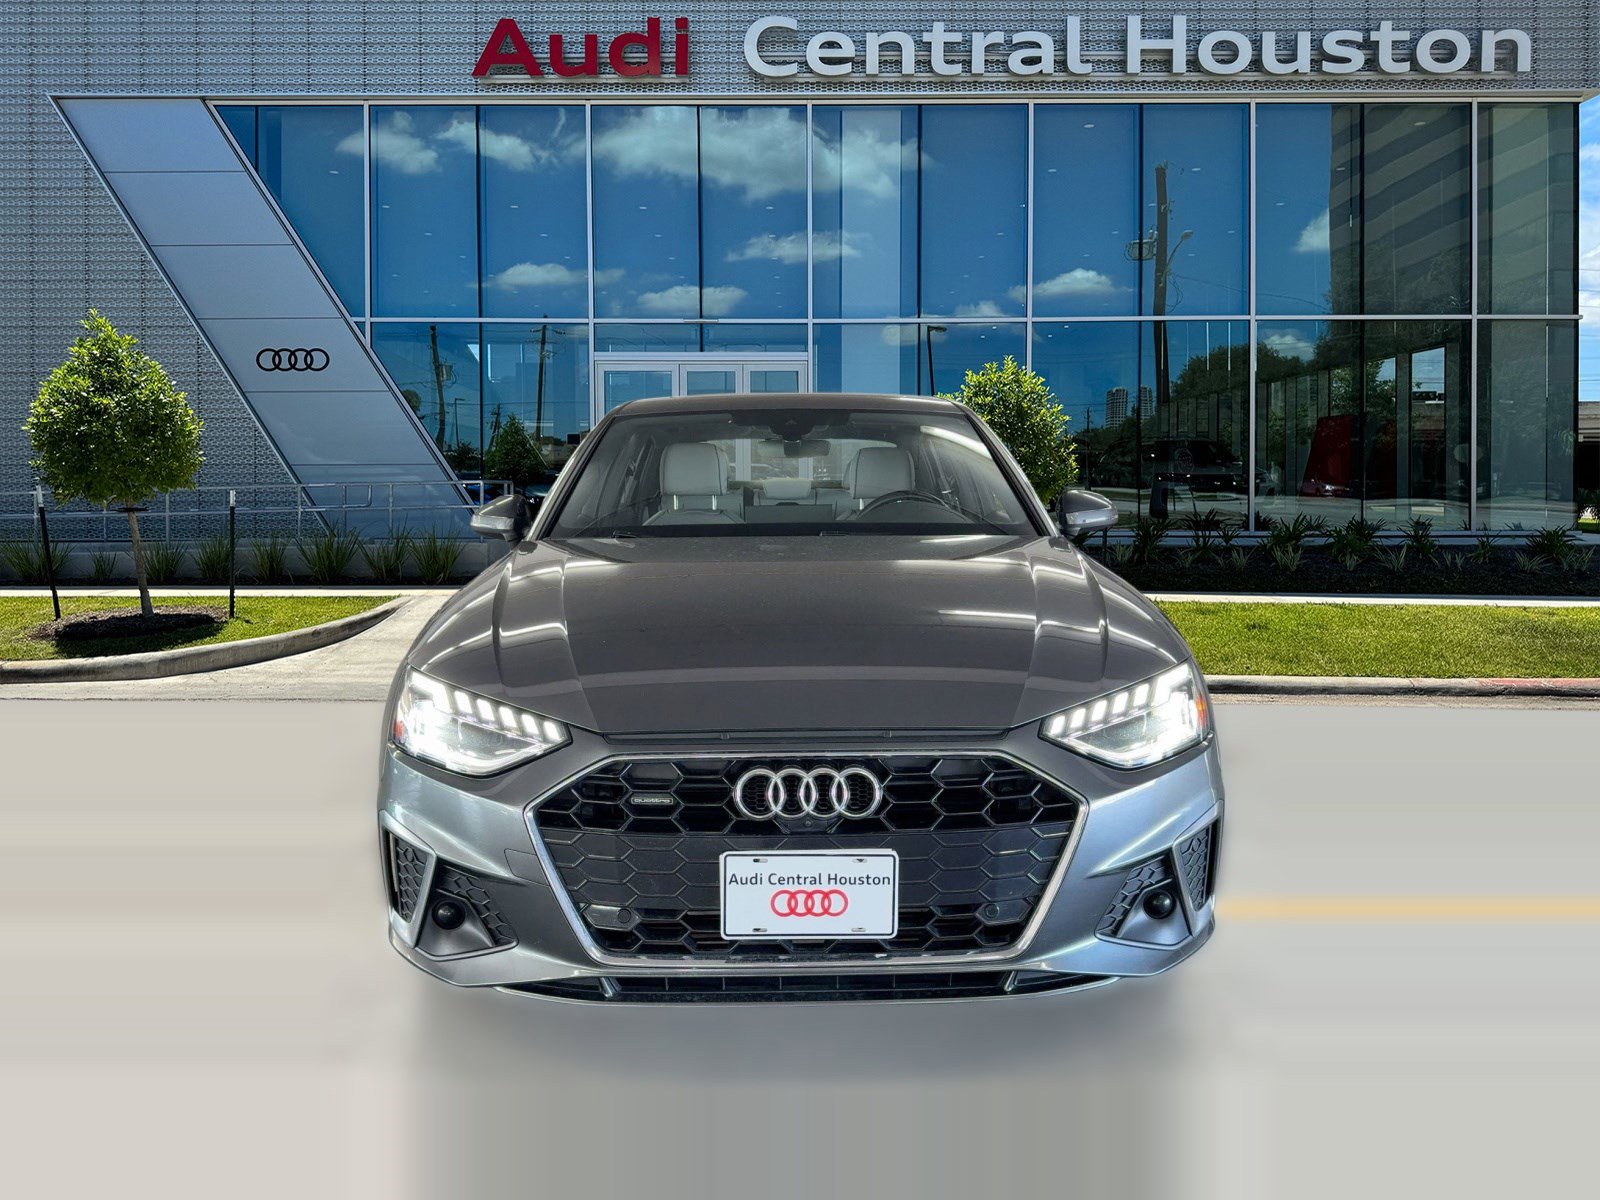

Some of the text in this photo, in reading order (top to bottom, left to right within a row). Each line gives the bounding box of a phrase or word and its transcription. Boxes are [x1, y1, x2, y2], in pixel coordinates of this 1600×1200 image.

[471, 15, 1532, 79] Audi Central Houston
[728, 872, 891, 886] Audi Central Houston
